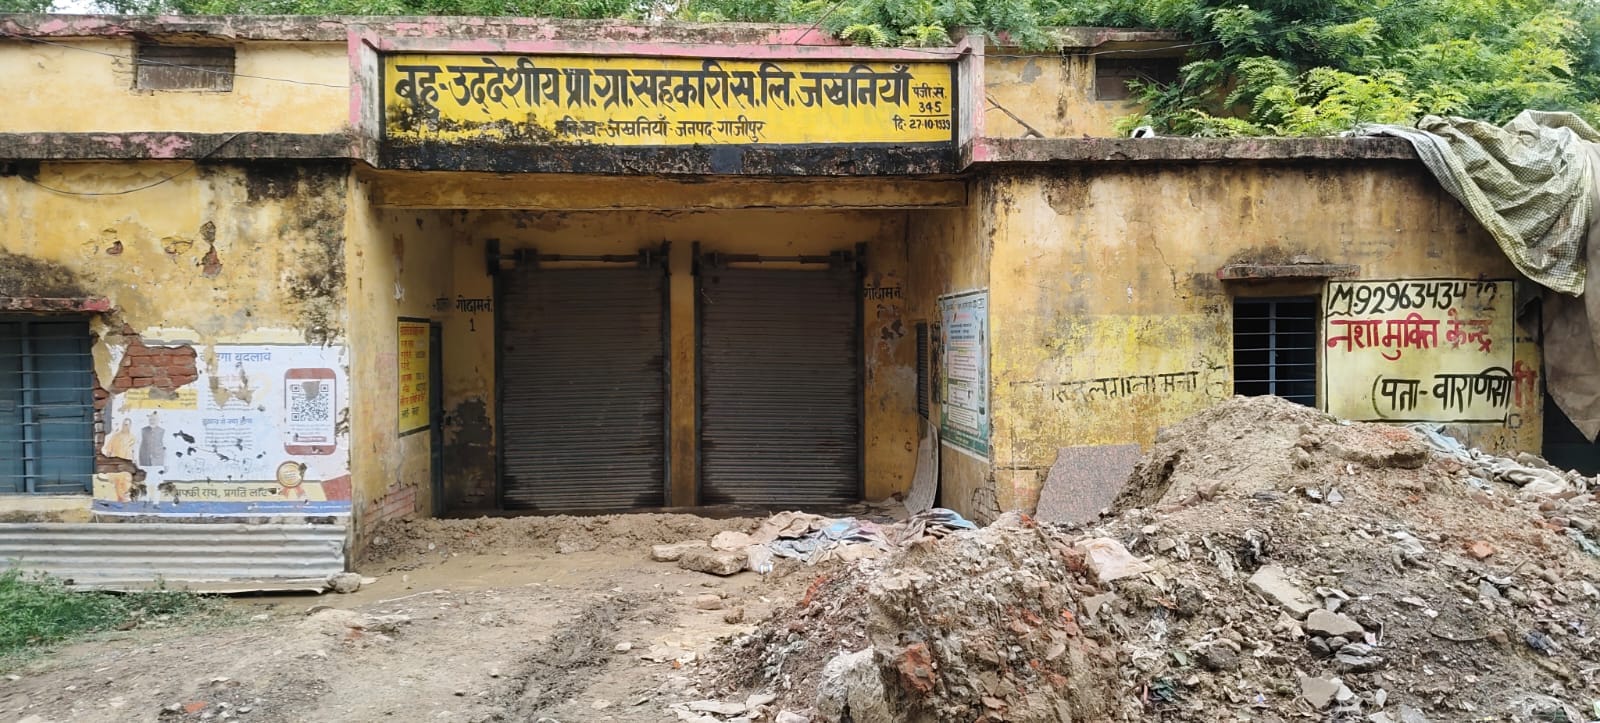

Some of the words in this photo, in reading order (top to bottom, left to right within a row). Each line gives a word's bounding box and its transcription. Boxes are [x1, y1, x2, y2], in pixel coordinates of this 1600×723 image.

[919, 101, 942, 114] 345
[1328, 320, 1382, 352] नशा
[1382, 312, 1440, 360] मुक्ति
[1432, 366, 1514, 413] वाराणसी
